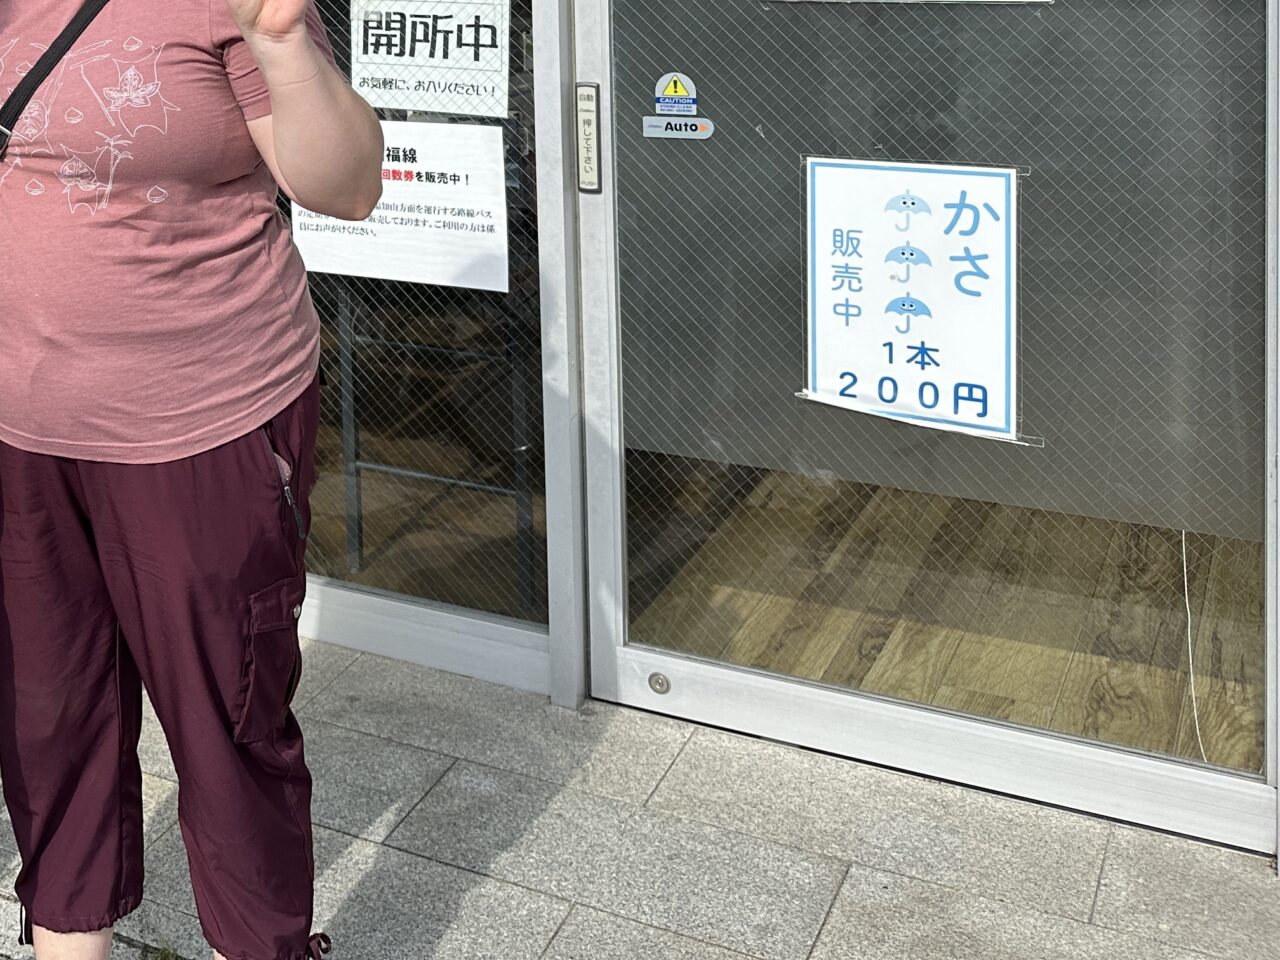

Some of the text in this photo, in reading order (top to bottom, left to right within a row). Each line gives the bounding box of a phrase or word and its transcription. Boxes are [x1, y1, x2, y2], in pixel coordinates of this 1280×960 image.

[362, 11, 499, 62] 開所中
[579, 93, 594, 102] 自動
[582, 118, 594, 174] 押して下さい
[664, 122, 698, 132] Auto
[382, 146, 418, 164] 福線
[942, 189, 1001, 298] かさ
[830, 227, 864, 328] 販売中
[882, 340, 941, 371] 1本
[838, 371, 989, 419] 200円
